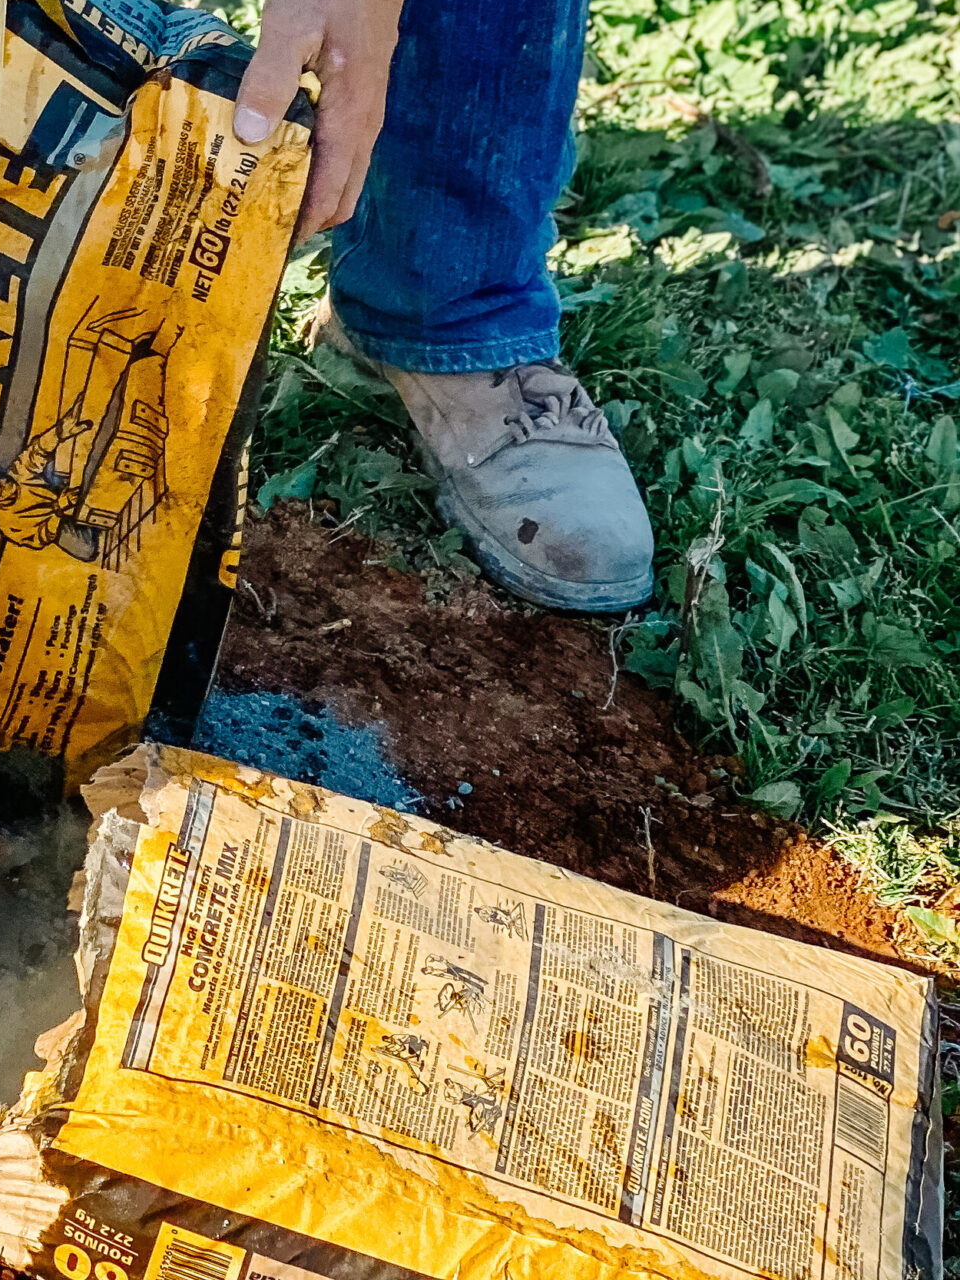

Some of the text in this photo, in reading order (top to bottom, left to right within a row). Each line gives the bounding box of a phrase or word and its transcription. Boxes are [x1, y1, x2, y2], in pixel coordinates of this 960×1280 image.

[181, 119, 194, 132] EN
[203, 155, 217, 170] LOS
[112, 206, 131, 238] CAUSES
[124, 178, 143, 208] SEVERE
[192, 152, 259, 302] NET 60 lb (27.2 kg)
[122, 250, 136, 270] KEEP
[129, 236, 142, 251] OUT
[81, 574, 97, 614] Strength
[60, 604, 78, 650] Footings
[144, 845, 190, 966] QUIKRETE
[181, 865, 212, 958] HIGH STRENGTH
[188, 841, 239, 993] CONCRETE MIX
[204, 976, 218, 1014] Mezcla
[211, 960, 223, 974] de
[217, 917, 233, 958] Concreto
[225, 901, 236, 915] de
[235, 839, 251, 880] Resistencia
[231, 1019, 245, 1054] Instructions
[845, 1014, 871, 1063] 60
[871, 1026, 881, 1070] POUNDS
[884, 1037, 894, 1050] kg
[311, 1079, 323, 1103] Project
[627, 1096, 653, 1195] QUIKRETE.COM
[64, 1224, 134, 1266] POUNDS
[76, 1209, 134, 1247] 27.2 kg
